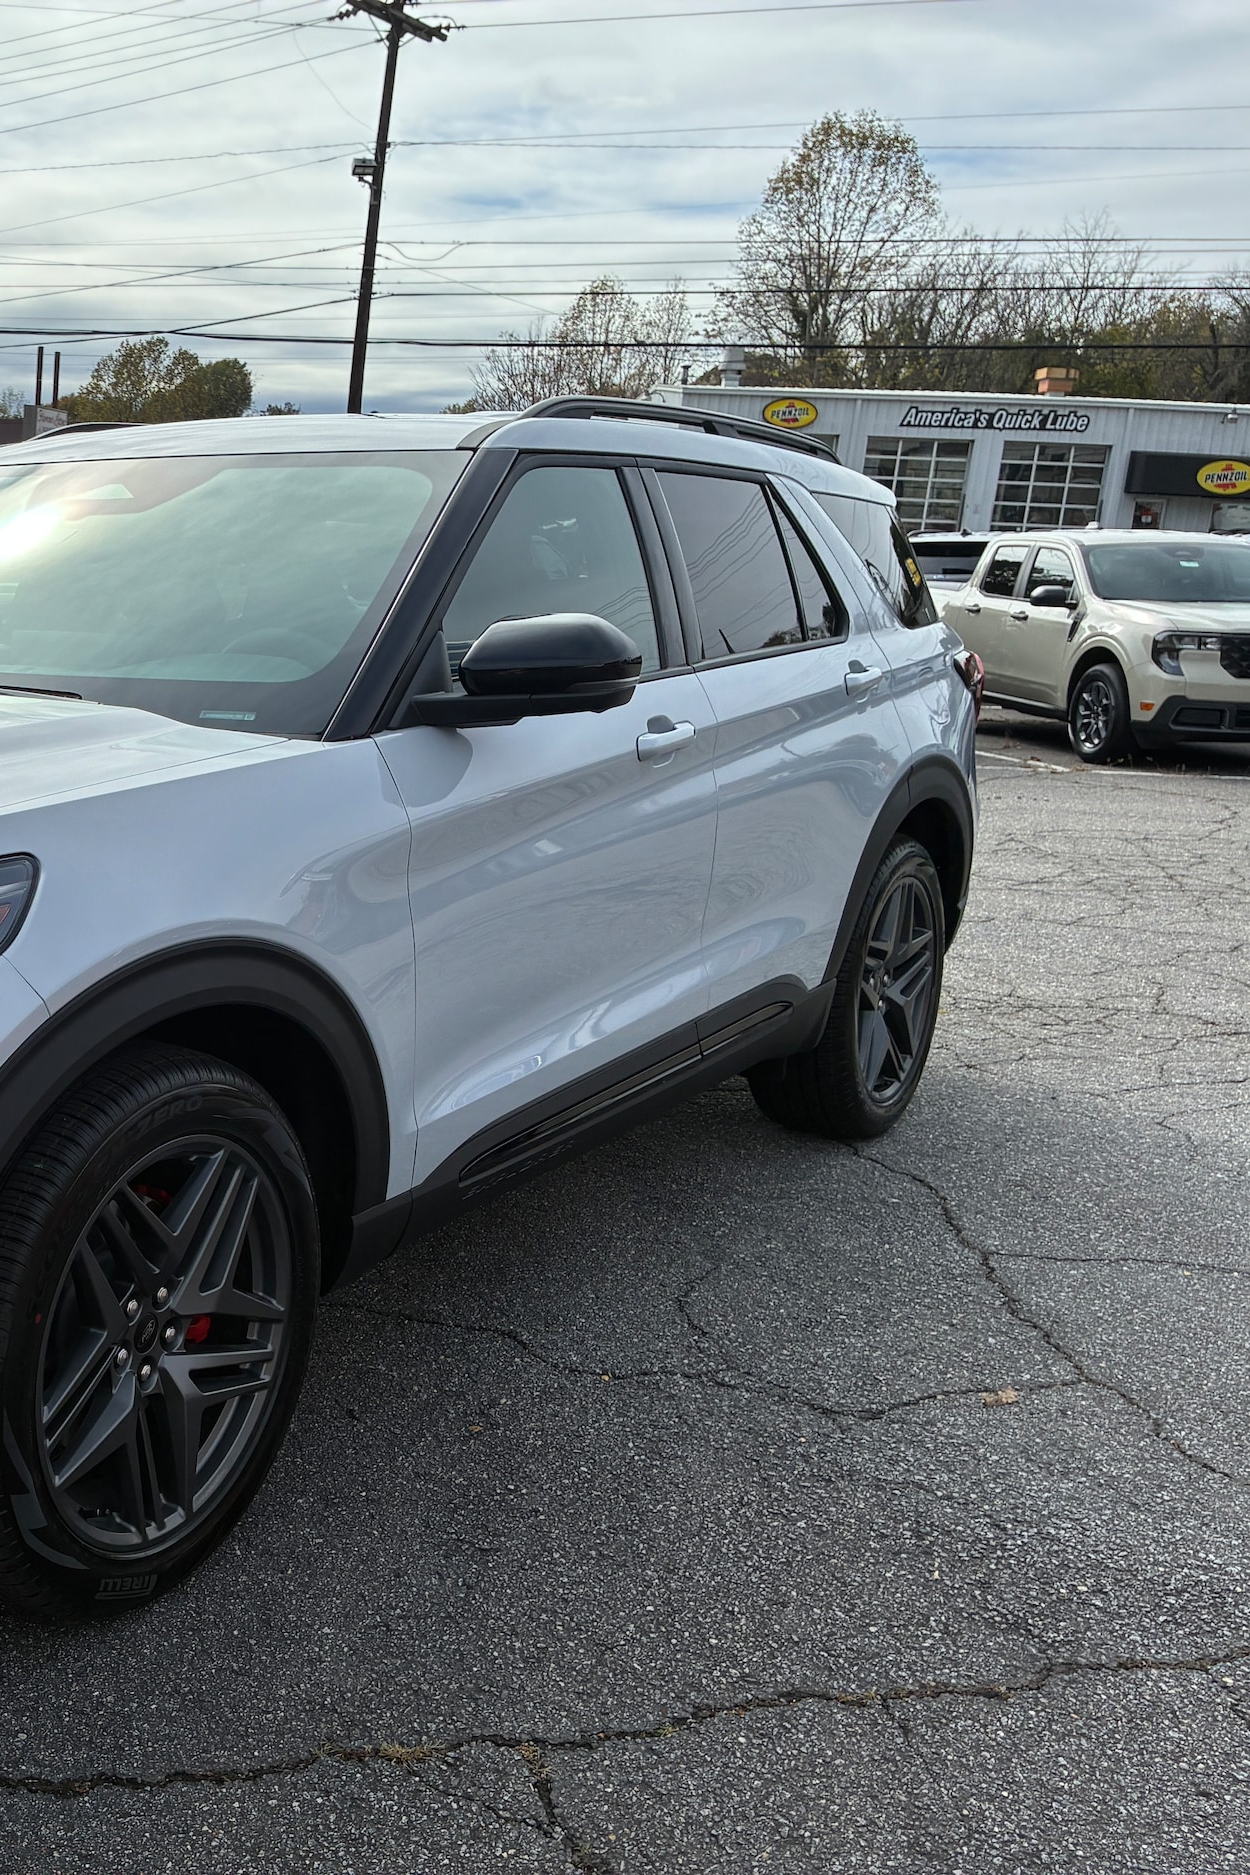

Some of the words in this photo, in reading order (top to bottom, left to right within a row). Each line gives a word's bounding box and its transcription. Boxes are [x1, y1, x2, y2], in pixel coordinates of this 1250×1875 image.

[770, 407, 810, 419] PENNZOIL
[901, 407, 990, 427] America's
[992, 409, 1044, 431] Quick
[1045, 411, 1090, 432] Lube
[1204, 470, 1248, 484] PENNZOIL
[94, 1573, 158, 1601] PIRELLI
